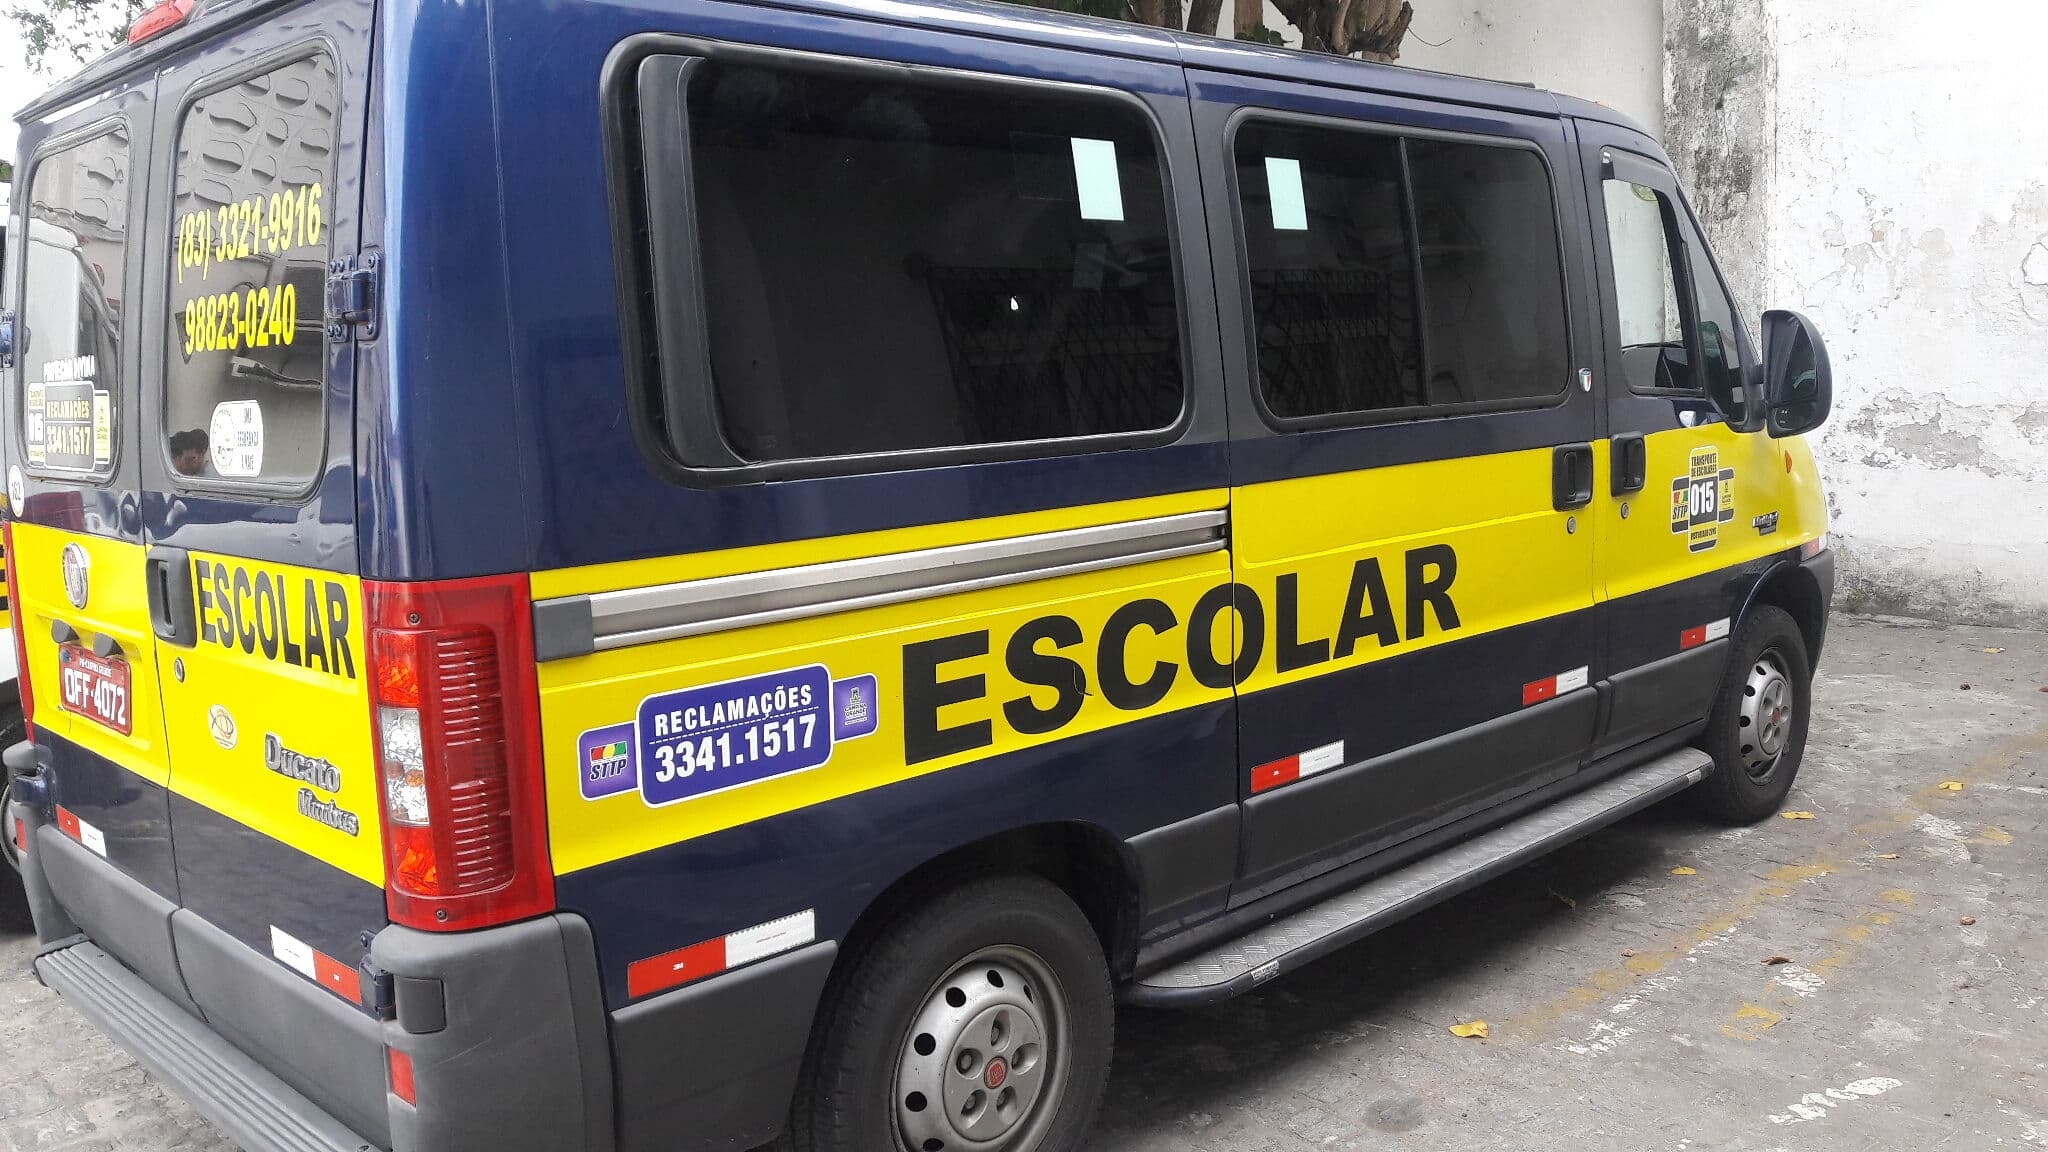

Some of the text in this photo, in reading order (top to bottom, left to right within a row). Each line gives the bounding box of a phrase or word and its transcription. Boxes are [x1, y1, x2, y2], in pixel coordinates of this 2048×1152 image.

[177, 182, 322, 283] (83) 3321-9916
[185, 283, 296, 355] 98823-0240
[46, 397, 90, 421] RECLAMAÇÕES
[46, 425, 91, 456] 3341.1517
[1672, 505, 1688, 520] STTP
[1690, 481, 1715, 516] 015
[195, 560, 356, 679] ESCOLAR
[902, 543, 1461, 765] ESCOLAR
[64, 667, 126, 725] OFF-4072
[655, 684, 812, 737] RECLAMAÇÕES
[265, 733, 340, 793] Ducato
[589, 757, 628, 781] STTP
[655, 713, 817, 783] 3341.1517
